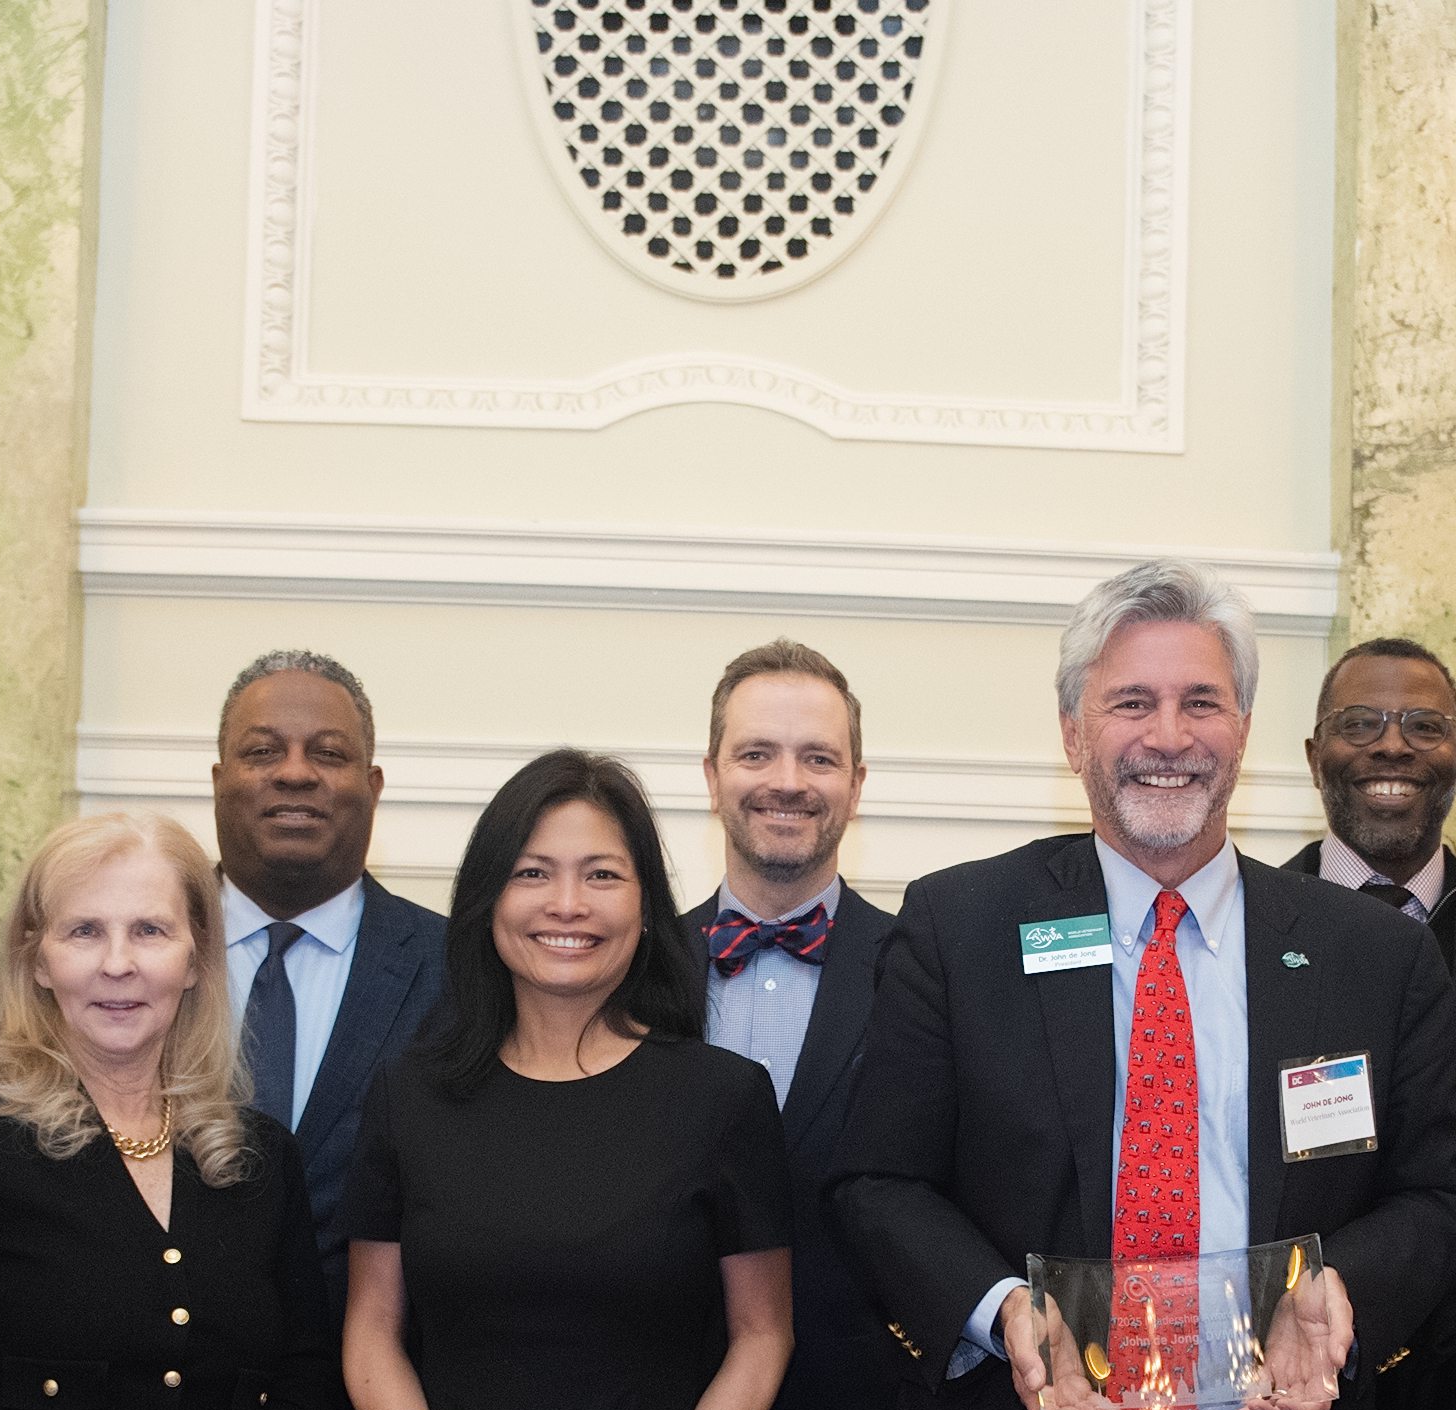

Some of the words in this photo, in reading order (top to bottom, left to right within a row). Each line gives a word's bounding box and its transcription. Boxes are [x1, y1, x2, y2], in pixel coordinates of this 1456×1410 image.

[1069, 951, 1078, 959] de
[1080, 950, 1097, 958] Jong
[1292, 1076, 1303, 1086] DC
[1302, 1100, 1322, 1111] JOHN
[1323, 1098, 1332, 1106] DE
[1333, 1094, 1354, 1105] JONG
[1122, 1334, 1151, 1347] John
